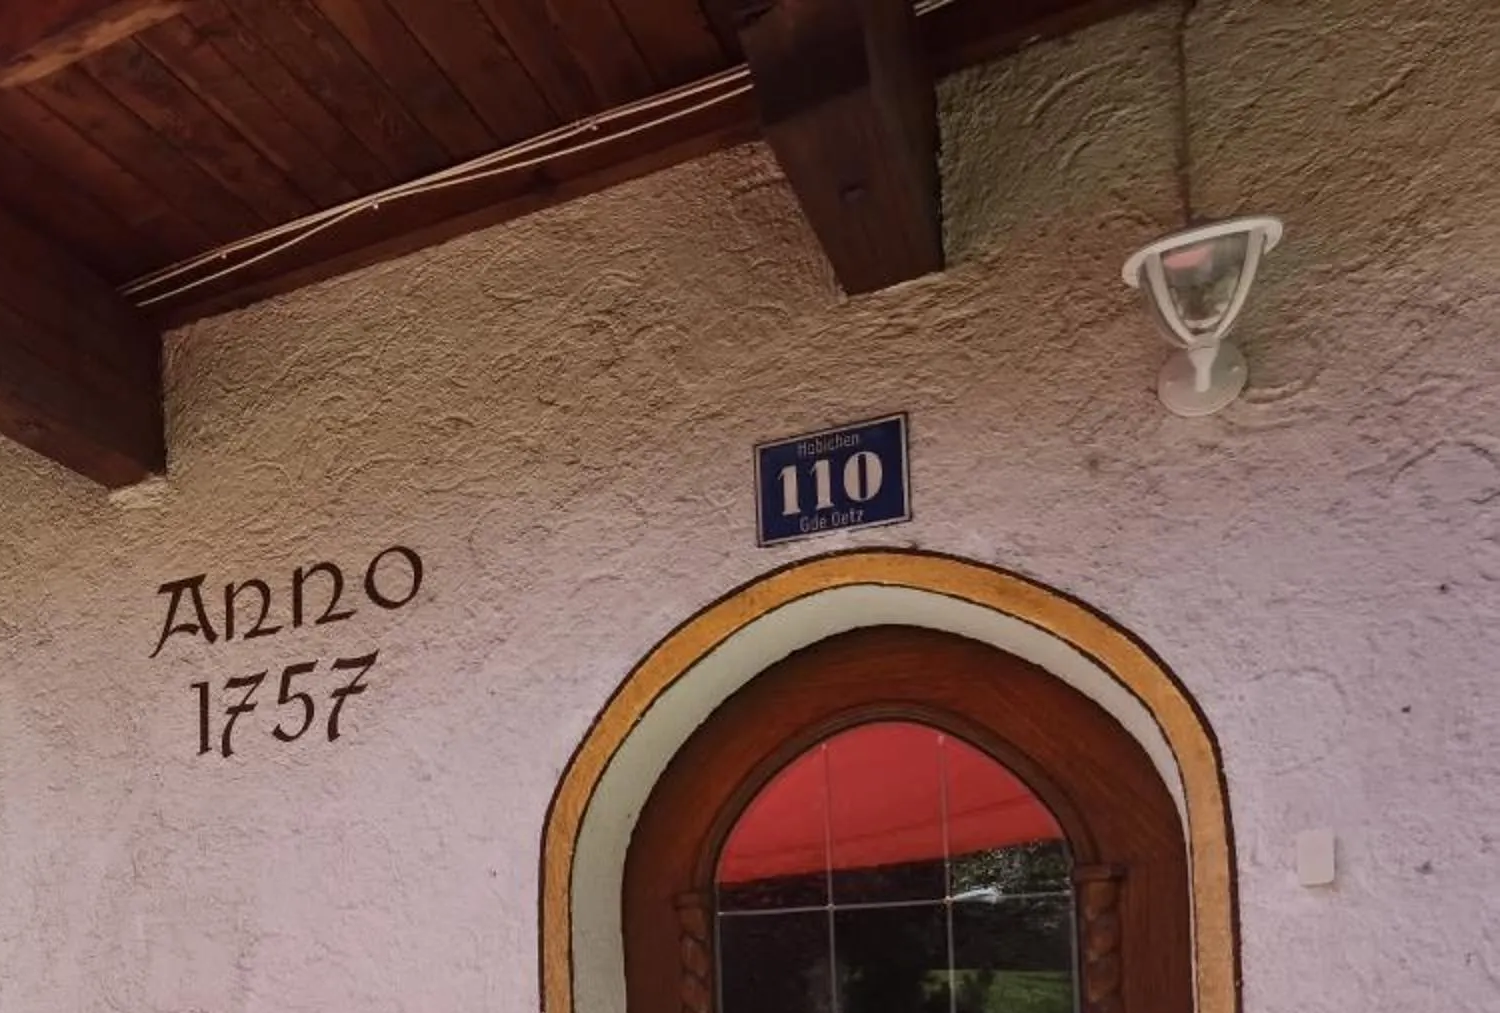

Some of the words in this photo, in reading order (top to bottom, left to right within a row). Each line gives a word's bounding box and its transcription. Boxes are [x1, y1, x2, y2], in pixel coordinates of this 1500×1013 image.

[797, 432, 860, 457] Habichen
[777, 451, 883, 516] 110
[831, 508, 865, 527] Oetz
[190, 649, 380, 758] 1757
